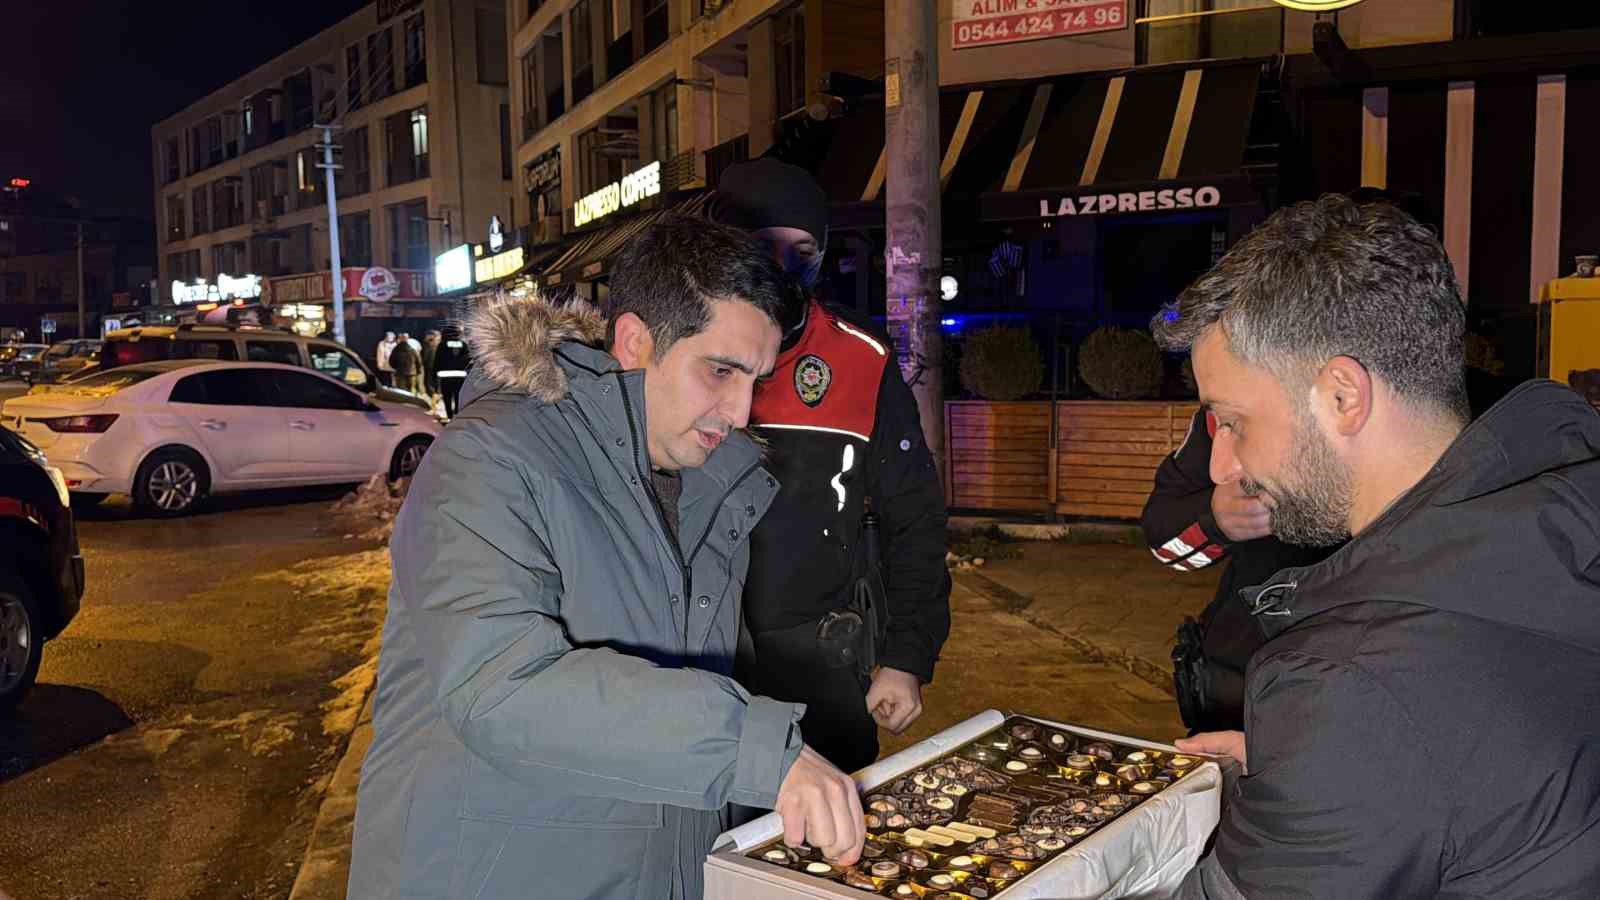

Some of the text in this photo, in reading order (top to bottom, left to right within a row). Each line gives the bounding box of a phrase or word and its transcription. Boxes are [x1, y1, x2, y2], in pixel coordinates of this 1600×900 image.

[971, 0, 1017, 16] ALIM
[958, 7, 1121, 42] 0544 424 74 96
[574, 161, 660, 227] LAZPRESSO COFFEE
[1040, 186, 1221, 216] LAZPRESSO
